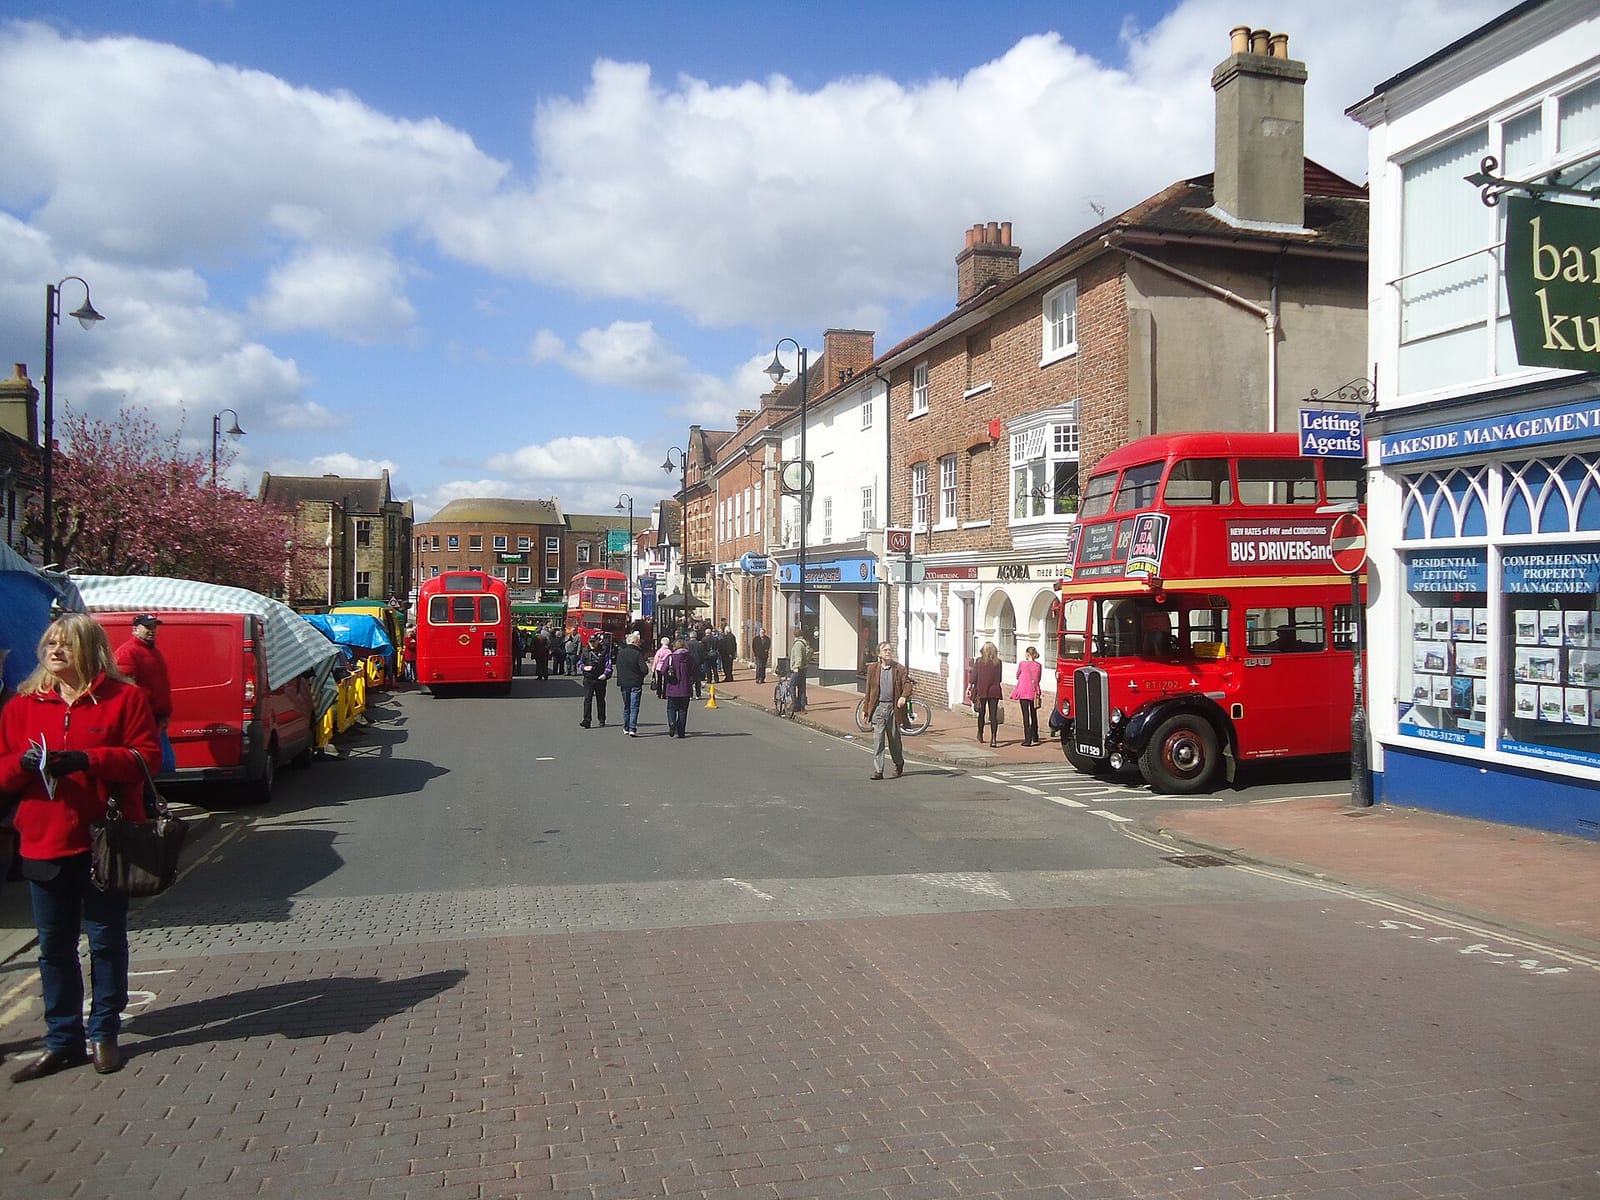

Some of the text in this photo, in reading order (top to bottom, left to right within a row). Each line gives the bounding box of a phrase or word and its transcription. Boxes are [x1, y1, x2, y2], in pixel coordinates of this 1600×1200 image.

[1301, 412, 1361, 437] Letting
[1381, 408, 1600, 457] LAKESIDE MANAGEMENT
[1304, 435, 1361, 455] Agents
[1230, 526, 1327, 536] NEW RATES of PAY and CONDITIONS
[1231, 541, 1256, 561] BUS
[1412, 557, 1479, 568] RESIDENTIAL
[997, 565, 1030, 580] AGORA
[1036, 568, 1052, 577] meze
[1423, 570, 1467, 580] LETTING
[1523, 568, 1587, 579] PROPERTY
[1413, 582, 1477, 592] SPECIALISTS
